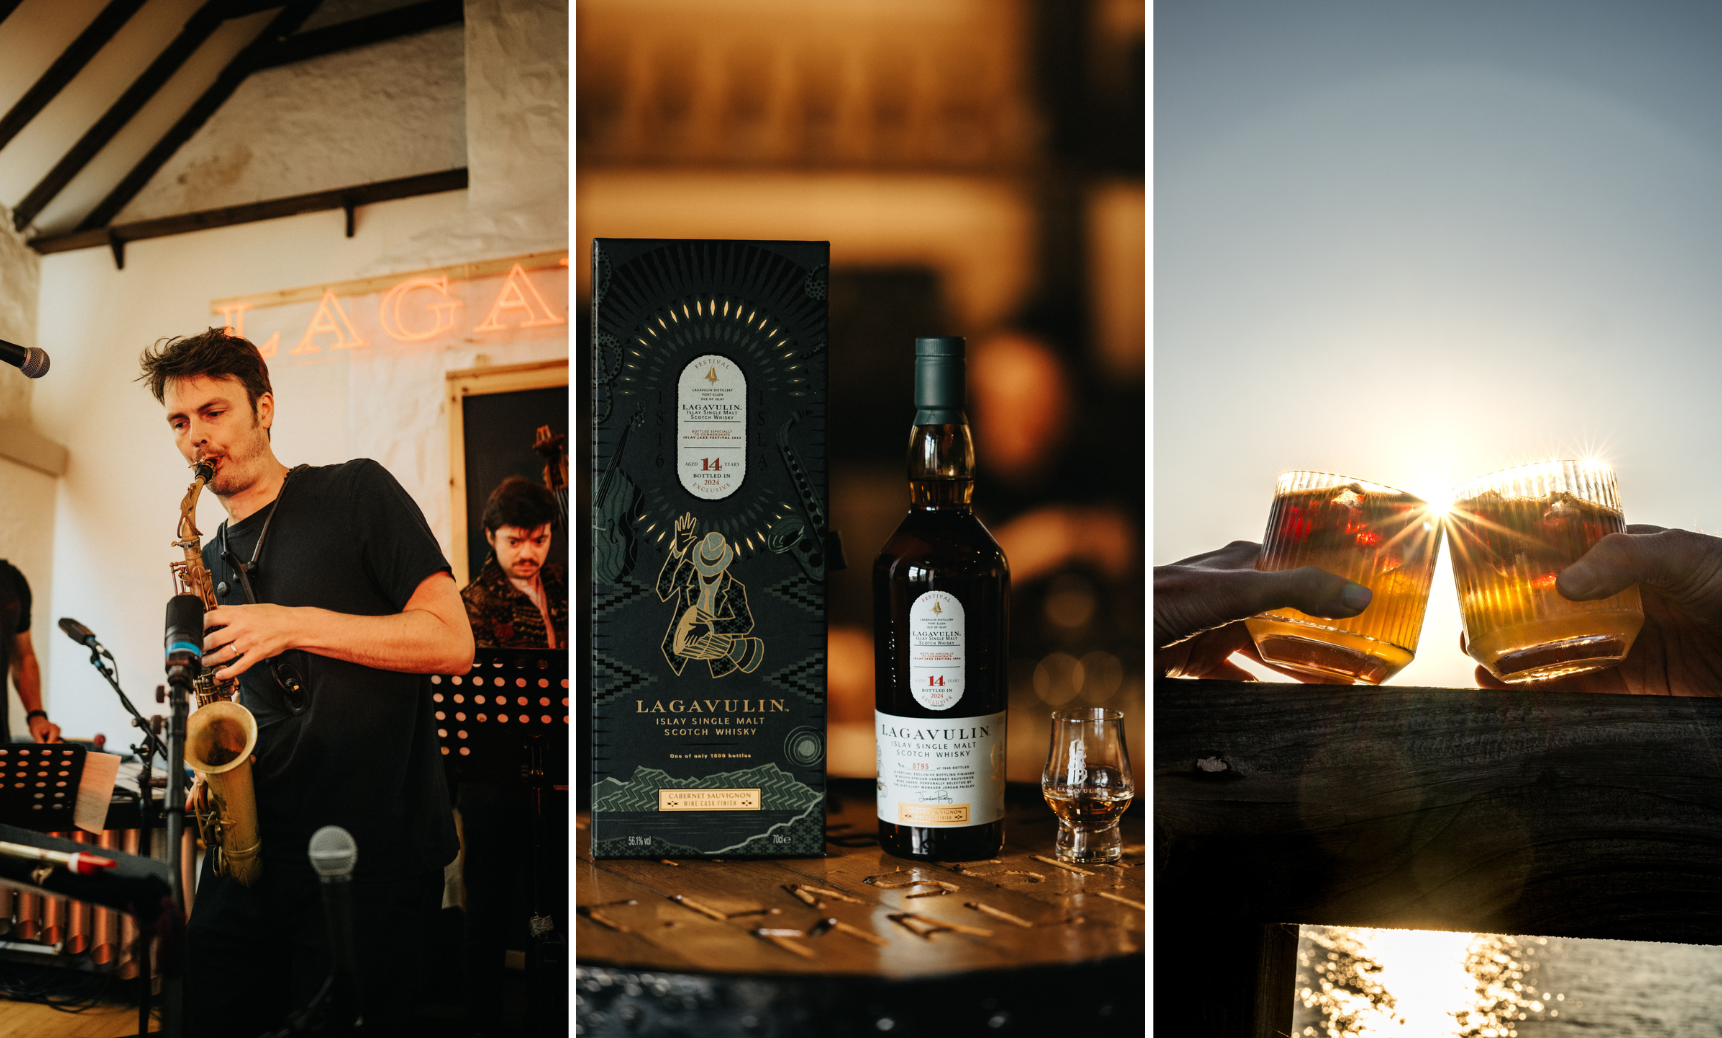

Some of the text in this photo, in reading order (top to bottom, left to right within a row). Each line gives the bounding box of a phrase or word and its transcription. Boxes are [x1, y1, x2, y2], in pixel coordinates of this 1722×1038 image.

[217, 258, 569, 359] LAGA
[694, 359, 730, 370] FESTIVAL
[700, 458, 722, 471] 14
[692, 482, 730, 493] EXCLUSIVE
[922, 594, 950, 602] FESTIVAL
[928, 675, 946, 686] 14
[896, 750, 930, 758] SCOTCH
[628, 836, 652, 846] 56.1% vol
